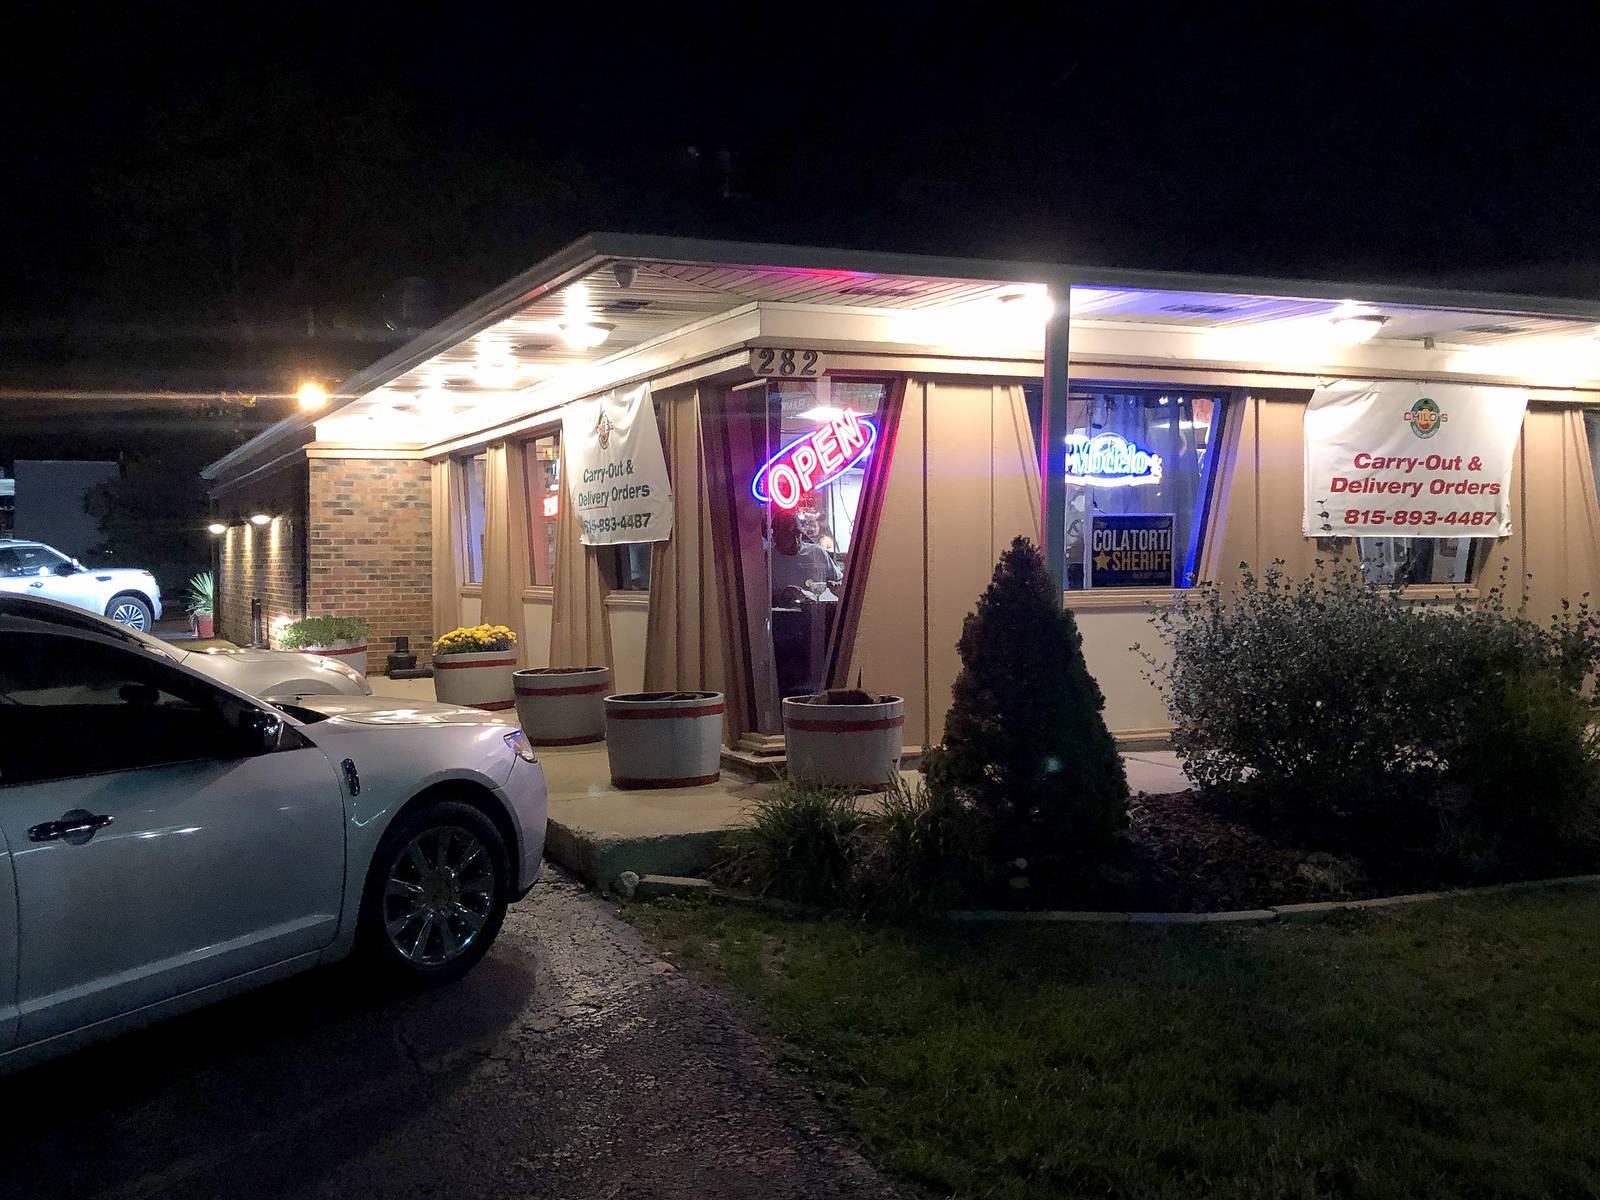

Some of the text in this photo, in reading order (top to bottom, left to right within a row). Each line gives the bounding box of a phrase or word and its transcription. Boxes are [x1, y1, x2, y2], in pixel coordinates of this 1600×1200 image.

[757, 349, 818, 375] 282
[769, 408, 865, 510] OPEN
[1353, 453, 1483, 473] Carry-Out &
[583, 459, 634, 483] Carry-Out &
[578, 484, 651, 507] Delivery Orders
[1330, 478, 1501, 498] Delivery Orders
[1343, 509, 1497, 526] 815-893-4487
[1093, 529, 1172, 551] COLATORTI
[1112, 551, 1171, 571] SHERIFF
